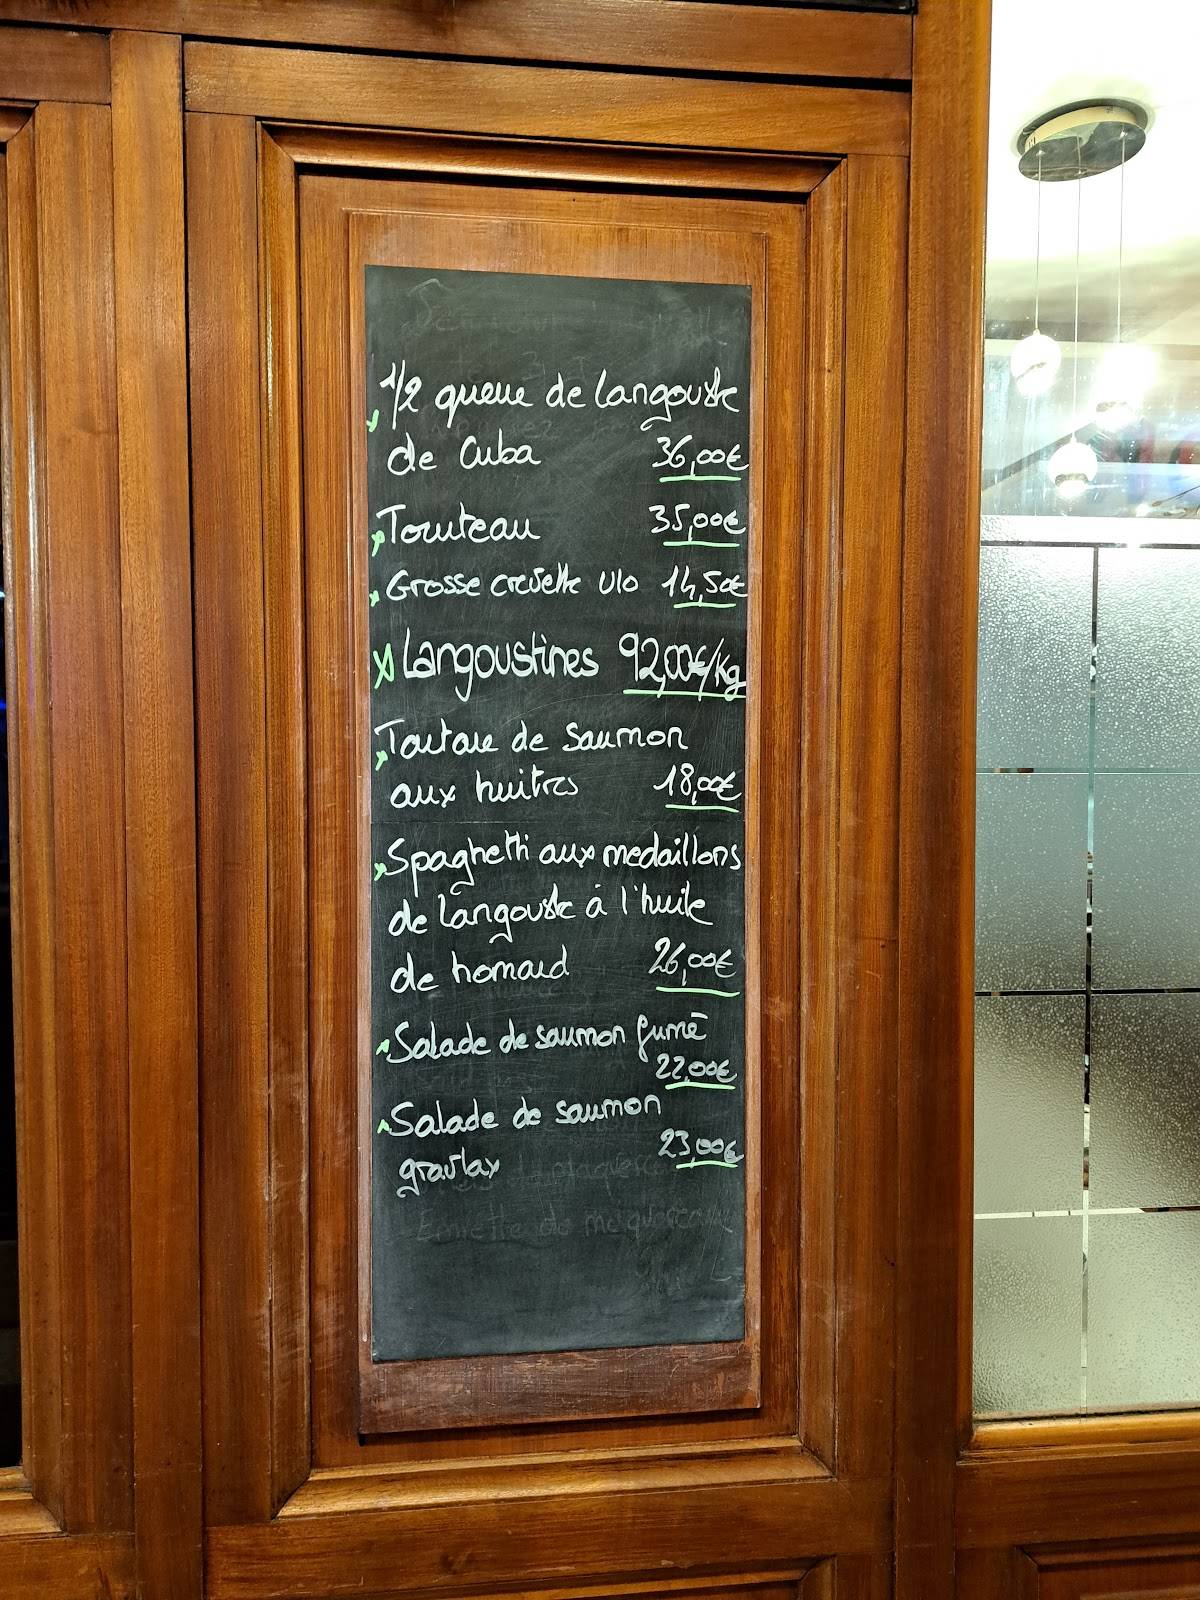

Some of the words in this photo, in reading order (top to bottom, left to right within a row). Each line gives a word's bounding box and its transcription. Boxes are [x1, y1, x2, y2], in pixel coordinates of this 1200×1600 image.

[435, 382, 534, 428] queue
[546, 372, 586, 408] de
[387, 432, 437, 476] de
[460, 429, 541, 469] Cuba
[651, 435, 749, 477] 36,00€
[649, 503, 746, 541] 35,00€
[386, 570, 481, 601] Grosse
[490, 563, 581, 595] crevette
[661, 566, 748, 604] 14,50€
[402, 628, 599, 701] Langoustines
[511, 720, 548, 751] de
[390, 782, 456, 808] aux
[476, 764, 578, 802] huitres
[653, 763, 742, 804] 18,00€
[384, 830, 529, 897] Spaghetti
[539, 842, 594, 868] aux
[603, 832, 741, 870] medaillons
[388, 899, 428, 936] de
[586, 884, 607, 918] à
[621, 881, 713, 925] l'huile
[391, 952, 439, 992] de
[648, 937, 736, 986] 26,00€
[386, 1021, 491, 1063] Salade
[500, 1019, 529, 1054] de
[637, 1012, 708, 1062] fumé
[656, 1053, 737, 1082] 22,00€
[389, 1099, 499, 1138] Salade
[512, 1096, 541, 1129] de
[397, 1147, 500, 1198] gravlax
